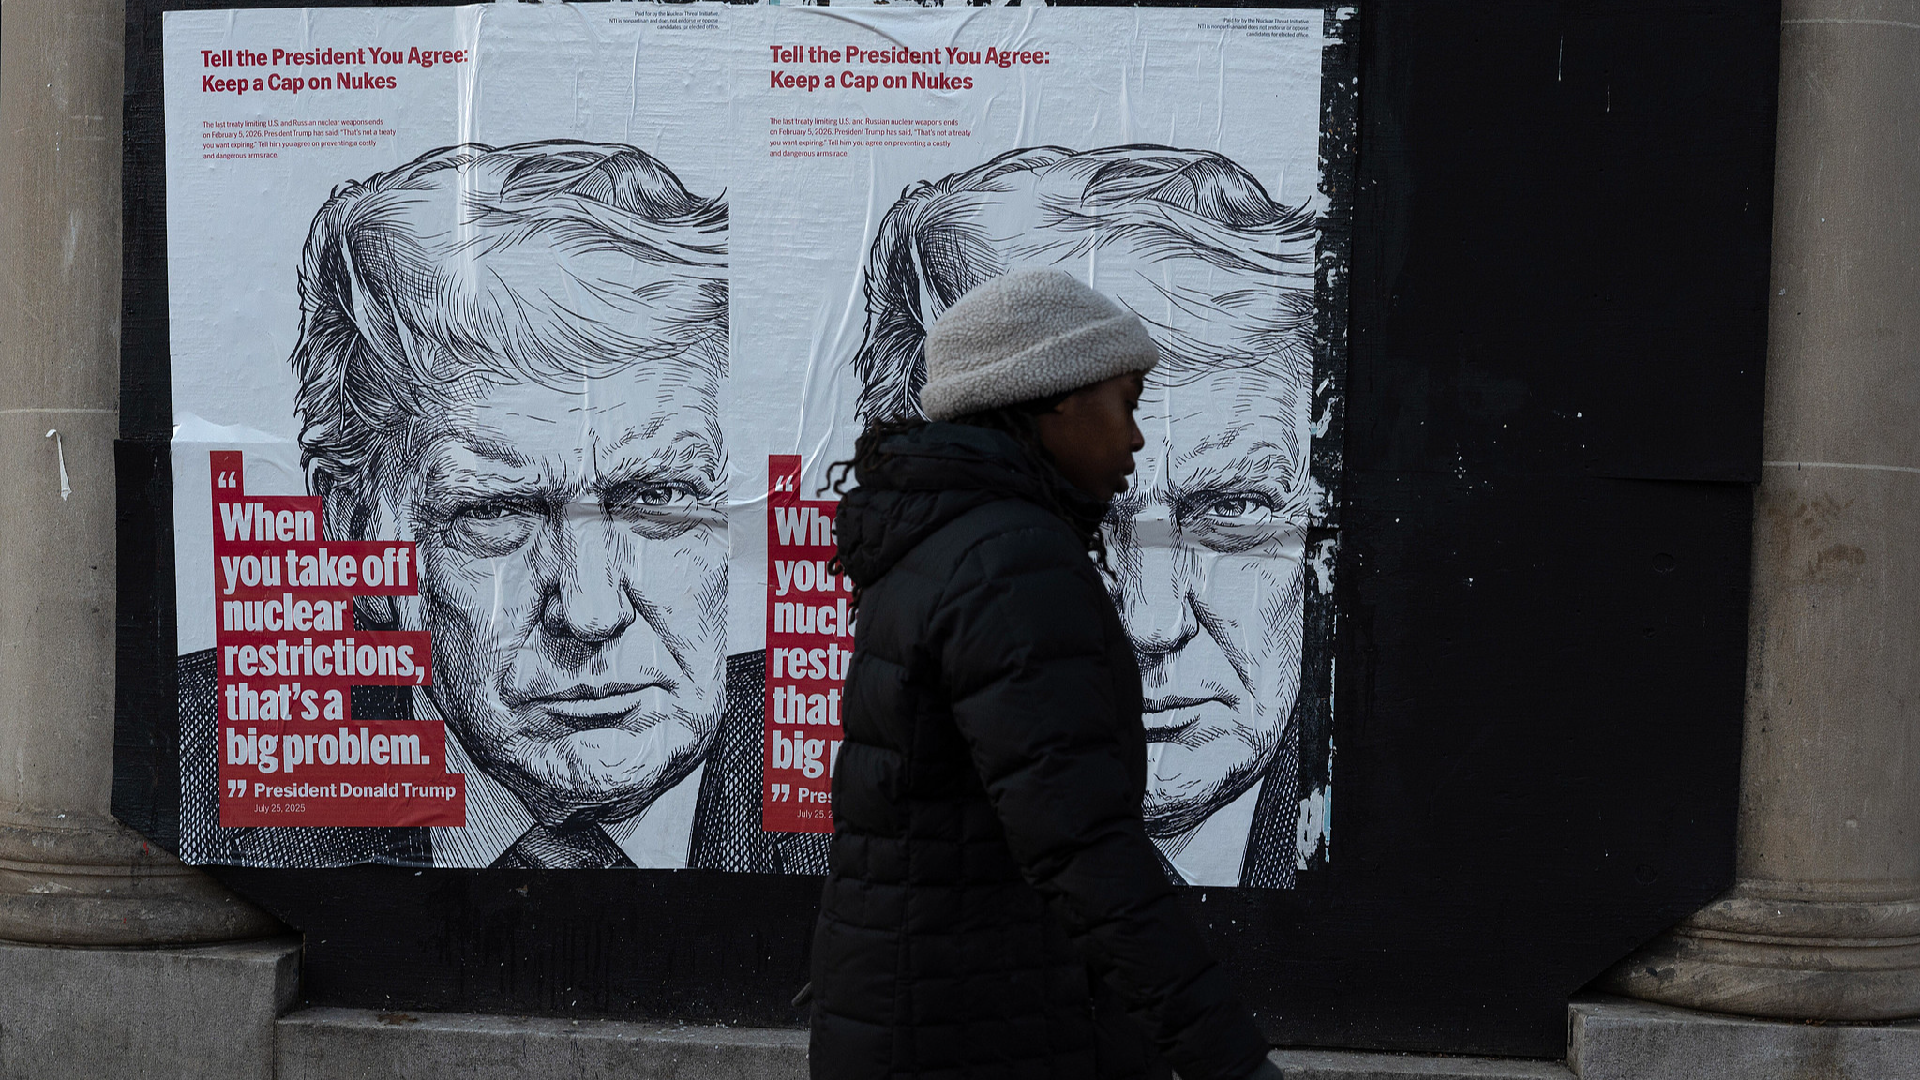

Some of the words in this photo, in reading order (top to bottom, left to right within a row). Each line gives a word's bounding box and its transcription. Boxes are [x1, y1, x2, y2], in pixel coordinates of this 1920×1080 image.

[201, 50, 233, 68] Tell
[236, 49, 267, 67] the
[272, 48, 366, 66] President
[368, 47, 404, 65] You
[407, 46, 469, 68] Agree:
[770, 45, 804, 63] Tell
[808, 46, 841, 63] the
[846, 46, 941, 65] President
[945, 46, 981, 65] You
[985, 46, 1049, 68] Agree:
[202, 74, 249, 95] Keep
[252, 78, 264, 91] a
[267, 73, 305, 94] Cap
[308, 76, 332, 90] on
[337, 72, 397, 90] Nukes
[770, 70, 820, 92] Keep
[824, 75, 835, 88] a
[840, 70, 878, 92] Cap
[882, 75, 907, 89] on
[911, 71, 973, 90] Nukes
[219, 502, 315, 541] When
[221, 555, 284, 595] you
[286, 548, 357, 587] take
[362, 547, 410, 587] off
[774, 560, 835, 596] you
[223, 592, 347, 631] nuclear
[224, 638, 425, 684] restrictions,
[225, 683, 319, 721] that's
[323, 688, 343, 721] a
[773, 685, 844, 726] that
[227, 728, 278, 774] big
[283, 727, 430, 773] problem.
[772, 730, 825, 779] big
[254, 783, 337, 798] President
[340, 783, 399, 798] Donald
[402, 783, 457, 801] Trump
[254, 803, 270, 813] July
[285, 803, 306, 813] 2025
[797, 809, 813, 819] July
